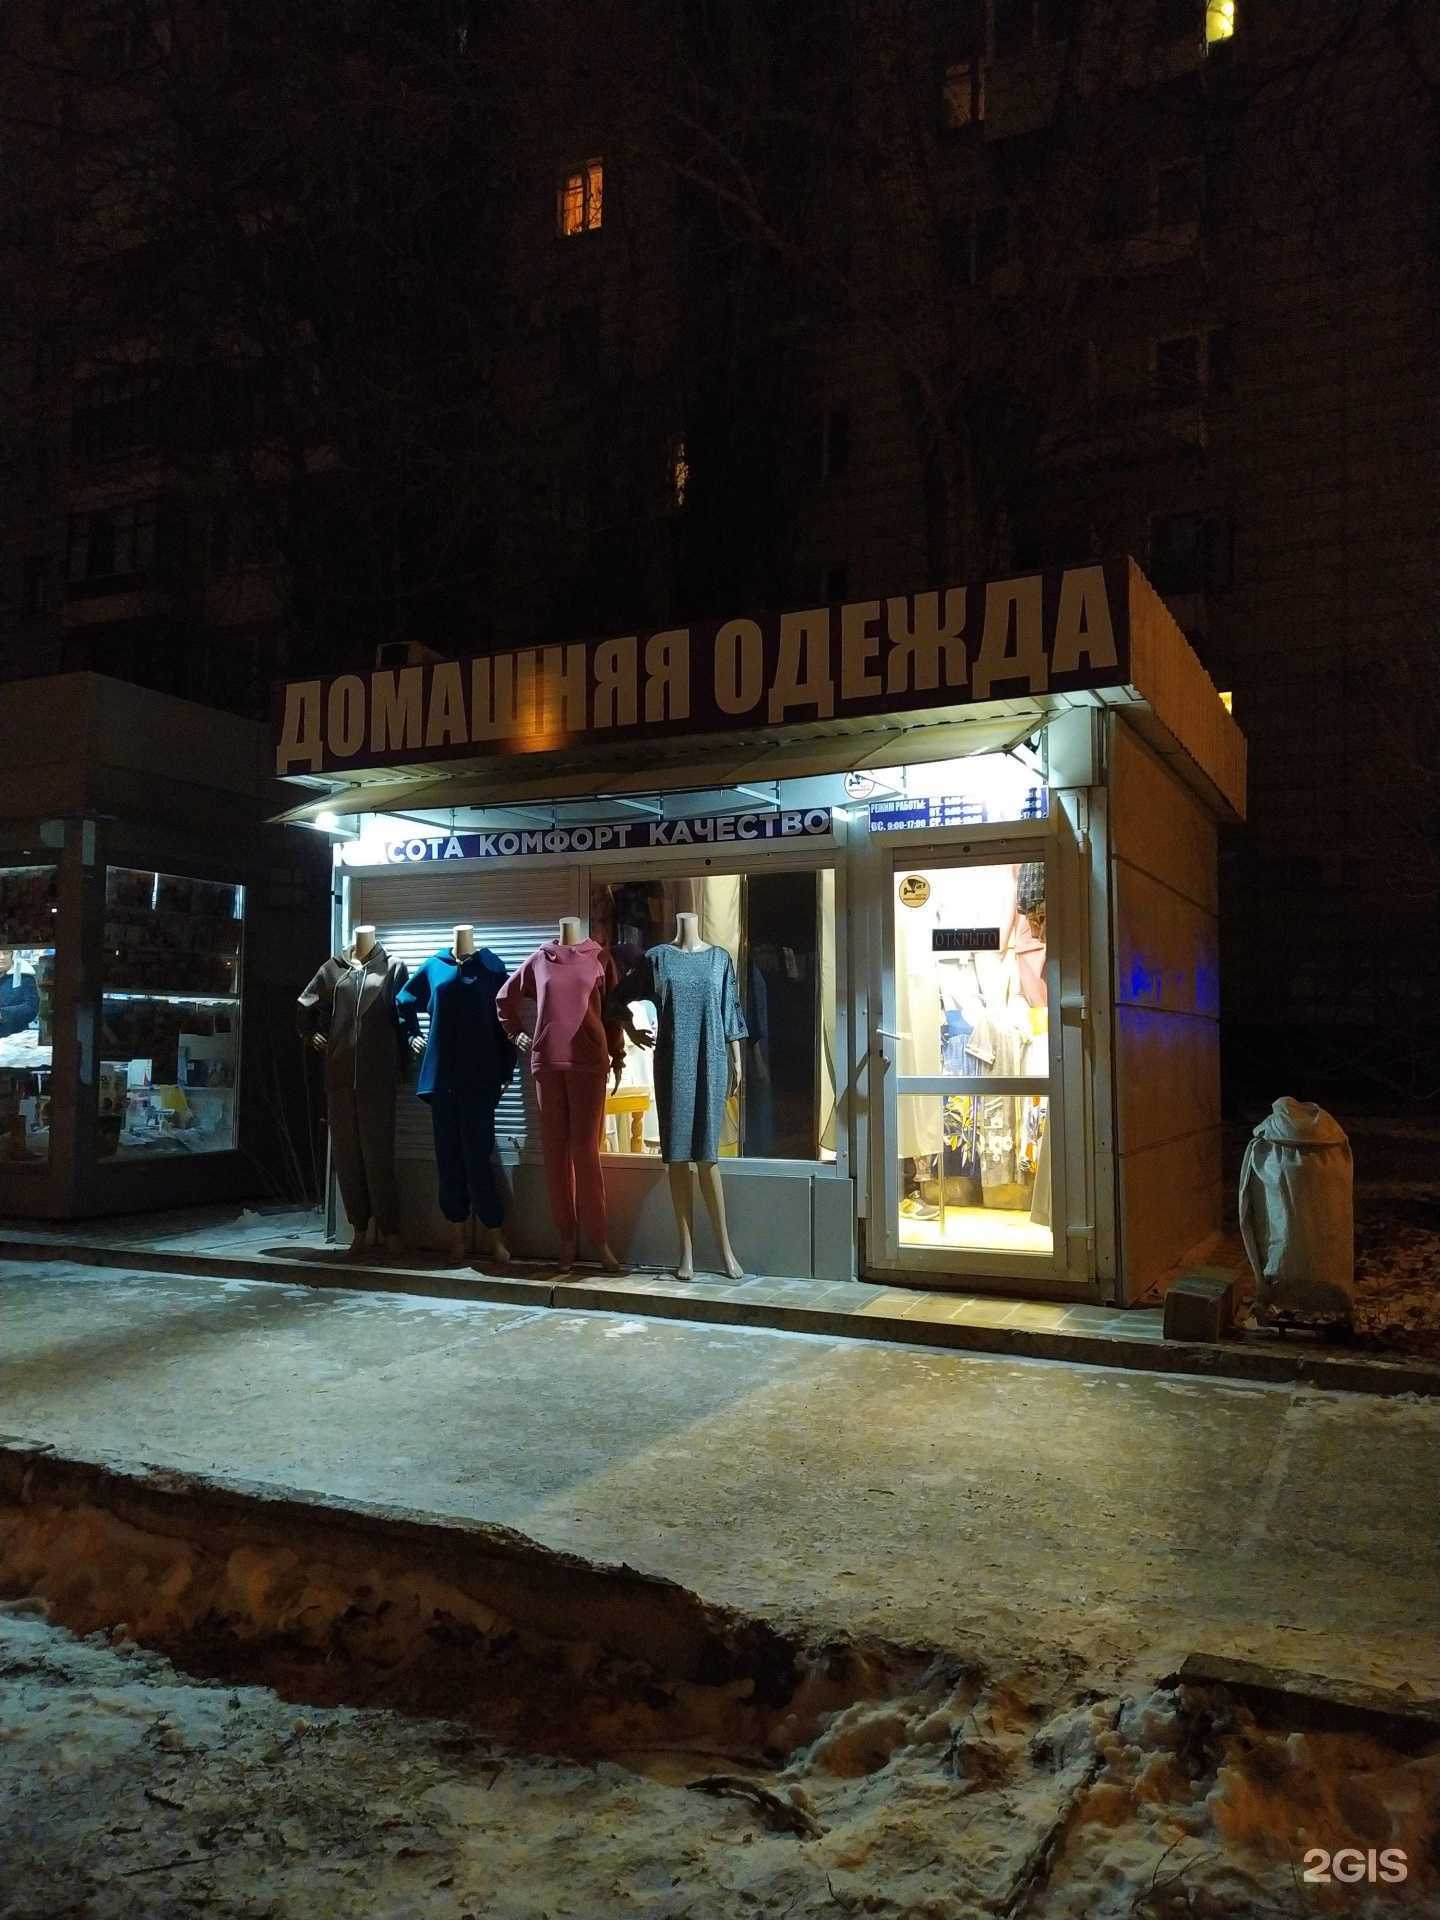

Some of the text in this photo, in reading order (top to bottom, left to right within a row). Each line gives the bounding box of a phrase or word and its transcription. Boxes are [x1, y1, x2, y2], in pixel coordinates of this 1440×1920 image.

[277, 566, 1119, 774] ДОМАШНЯЯ ОДЕЖДА
[479, 825, 632, 855] КОМФОРТ
[649, 809, 830, 844] КАЧЕСТВО
